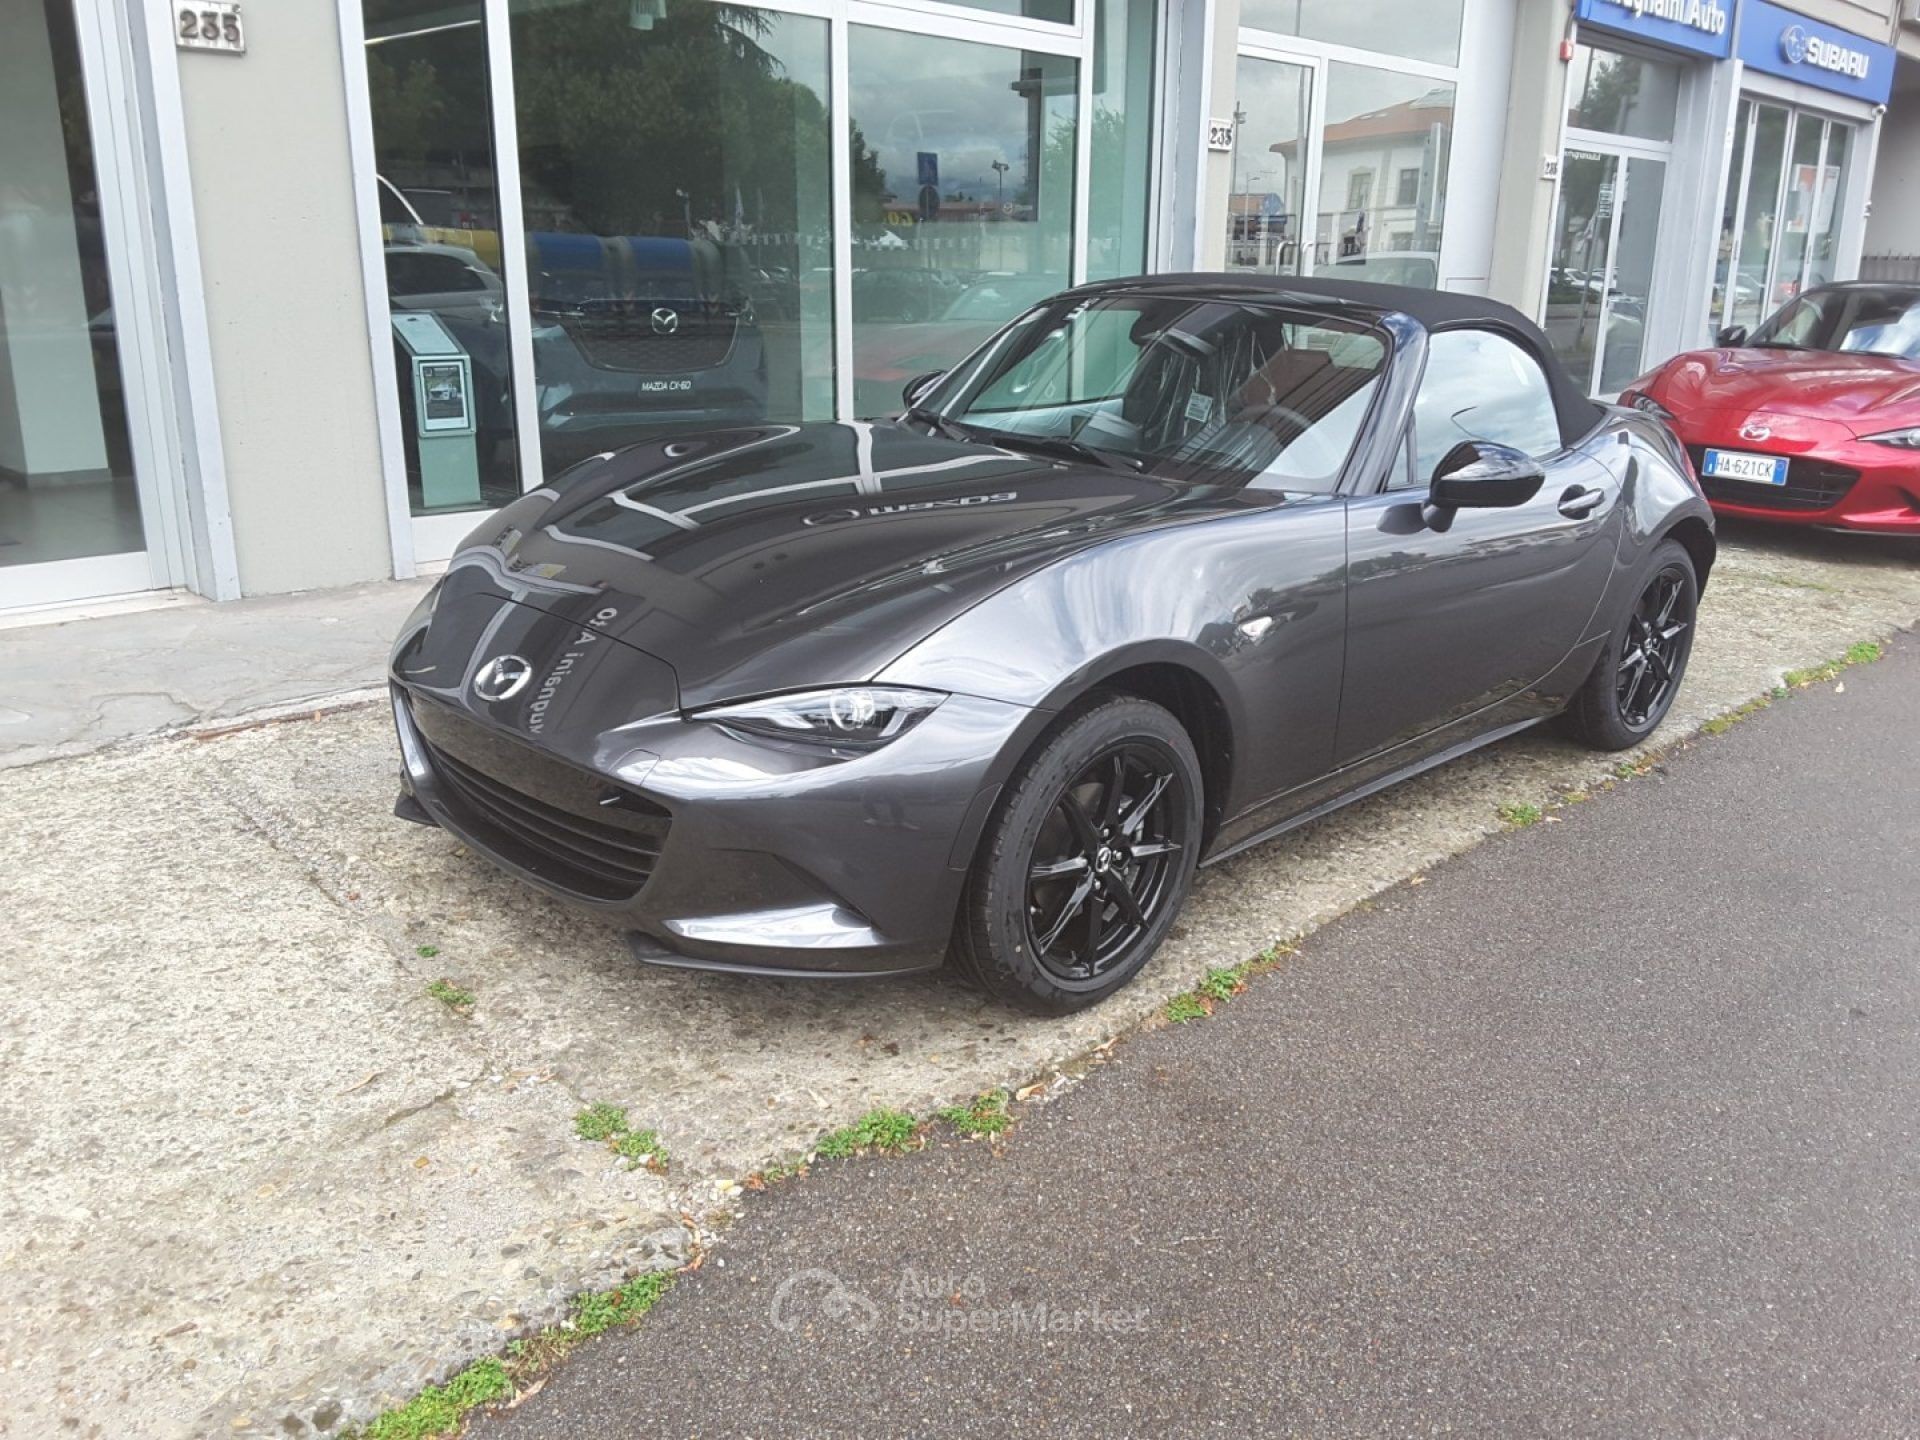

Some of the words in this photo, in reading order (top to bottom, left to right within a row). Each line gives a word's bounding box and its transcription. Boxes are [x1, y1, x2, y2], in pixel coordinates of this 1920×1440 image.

[179, 9, 241, 42] 235
[1684, 0, 1726, 34] Auto
[1807, 36, 1869, 79] SUBARU
[1210, 127, 1232, 146] 235
[641, 381, 668, 391] MAZDA
